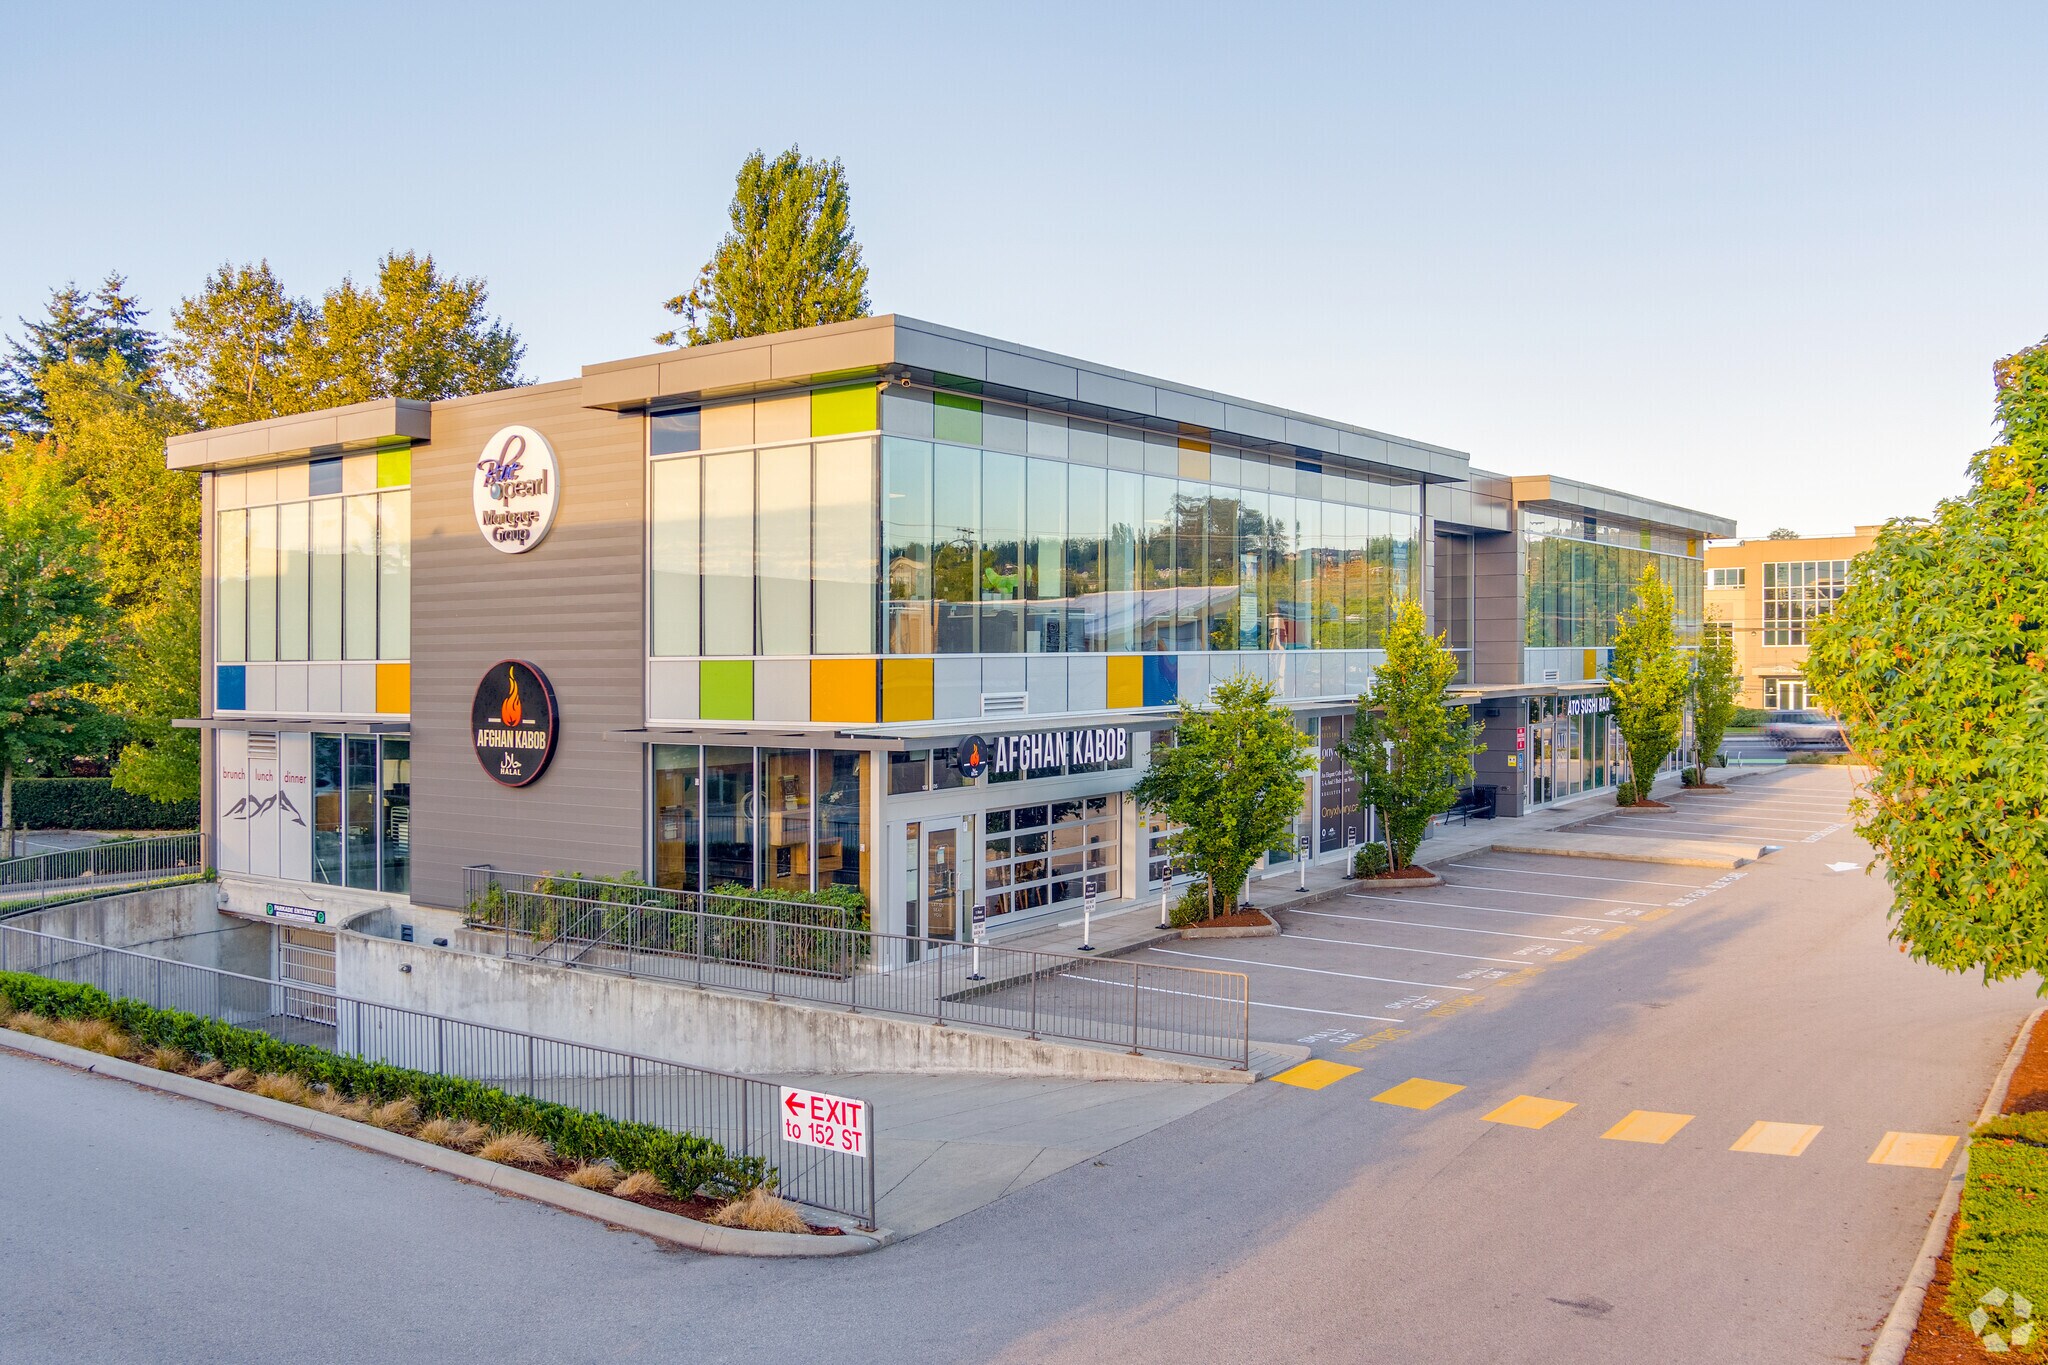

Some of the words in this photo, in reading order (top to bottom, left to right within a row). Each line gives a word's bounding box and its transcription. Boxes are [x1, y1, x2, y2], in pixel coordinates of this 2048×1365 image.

[502, 469, 548, 507] pearl
[482, 510, 540, 527] Mortgage
[492, 526, 531, 545] Group
[1567, 700, 1580, 716] ATO
[1580, 698, 1598, 714] SUSHI
[1598, 696, 1610, 712] BAR
[476, 729, 513, 748] AFGHAN
[515, 730, 546, 749] KABOB
[995, 731, 1067, 773] AFGHAN
[1073, 727, 1127, 765] KABOB
[222, 766, 246, 780] brunch
[255, 768, 273, 781] lunch
[283, 770, 307, 784] dinner
[500, 768, 521, 776] HALAL
[1412, 998, 1443, 1010] CAR
[1297, 1027, 1347, 1044] SMALL
[1328, 1032, 1364, 1043] CAR
[811, 1095, 862, 1128] EXIT
[785, 1118, 802, 1140] to
[808, 1122, 835, 1147] 152
[841, 1128, 863, 1152] ST
